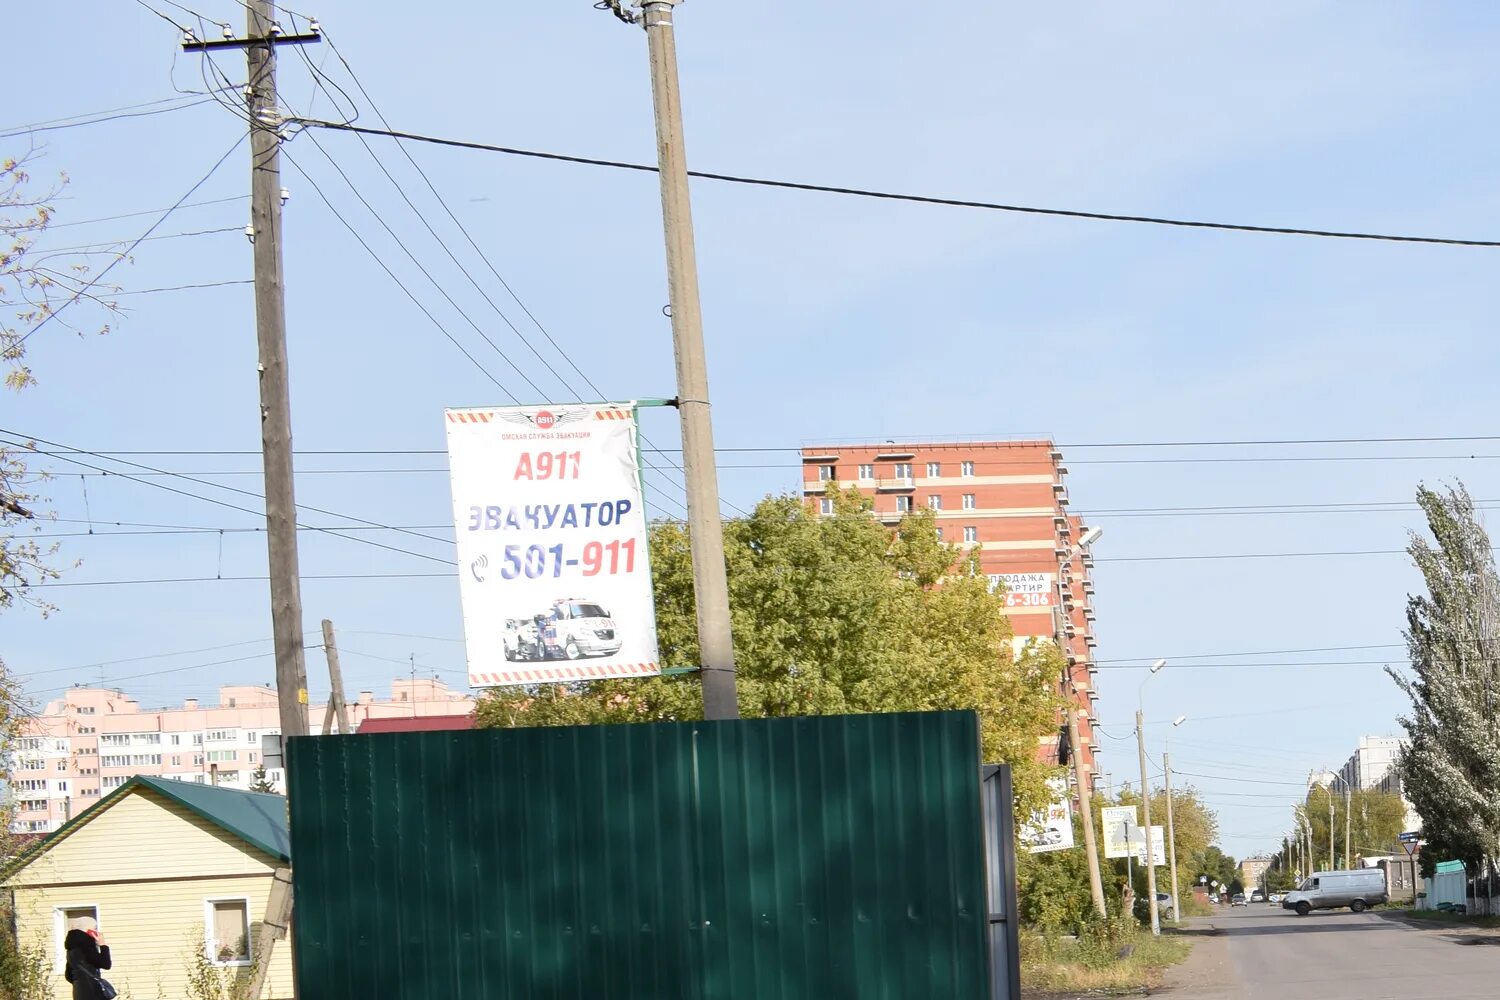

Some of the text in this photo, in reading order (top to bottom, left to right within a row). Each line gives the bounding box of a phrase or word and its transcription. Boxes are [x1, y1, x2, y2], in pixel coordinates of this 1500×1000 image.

[528, 432, 554, 440] СЛУЖБА
[513, 450, 581, 481] А911
[467, 499, 632, 532] ЭВАКУАТОР
[500, 537, 636, 580] 501-911
